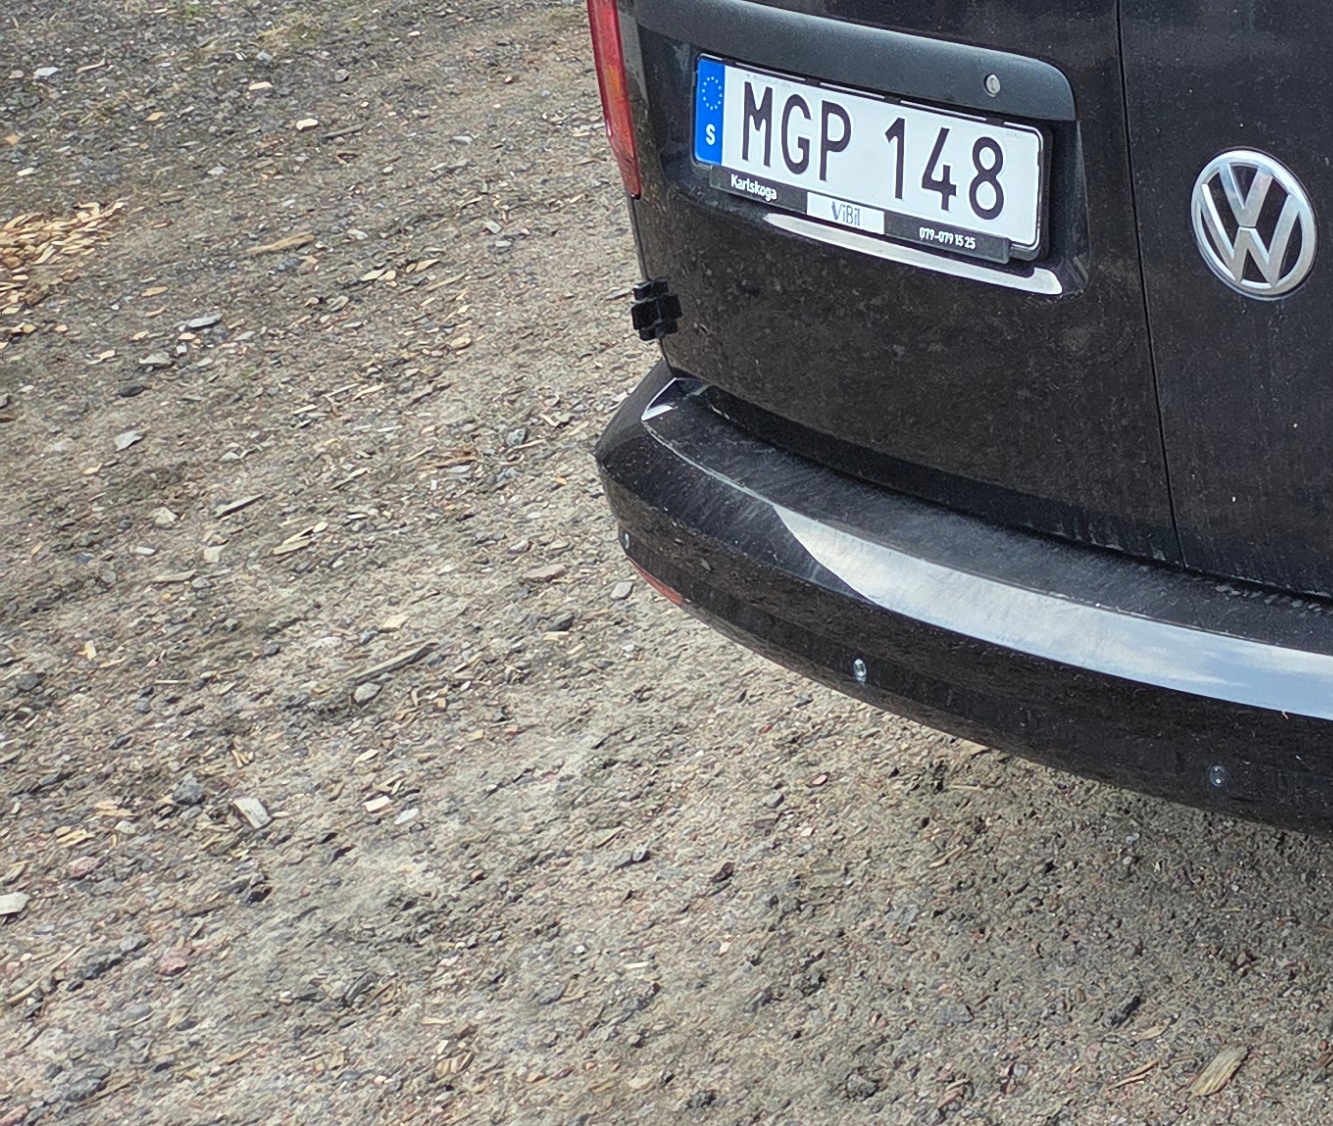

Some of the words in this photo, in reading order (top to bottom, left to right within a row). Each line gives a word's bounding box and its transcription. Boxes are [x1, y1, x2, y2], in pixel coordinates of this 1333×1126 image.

[705, 123, 716, 146] S
[741, 81, 851, 182] MGP
[884, 117, 1005, 221] 148
[730, 173, 778, 202] Karlskoga
